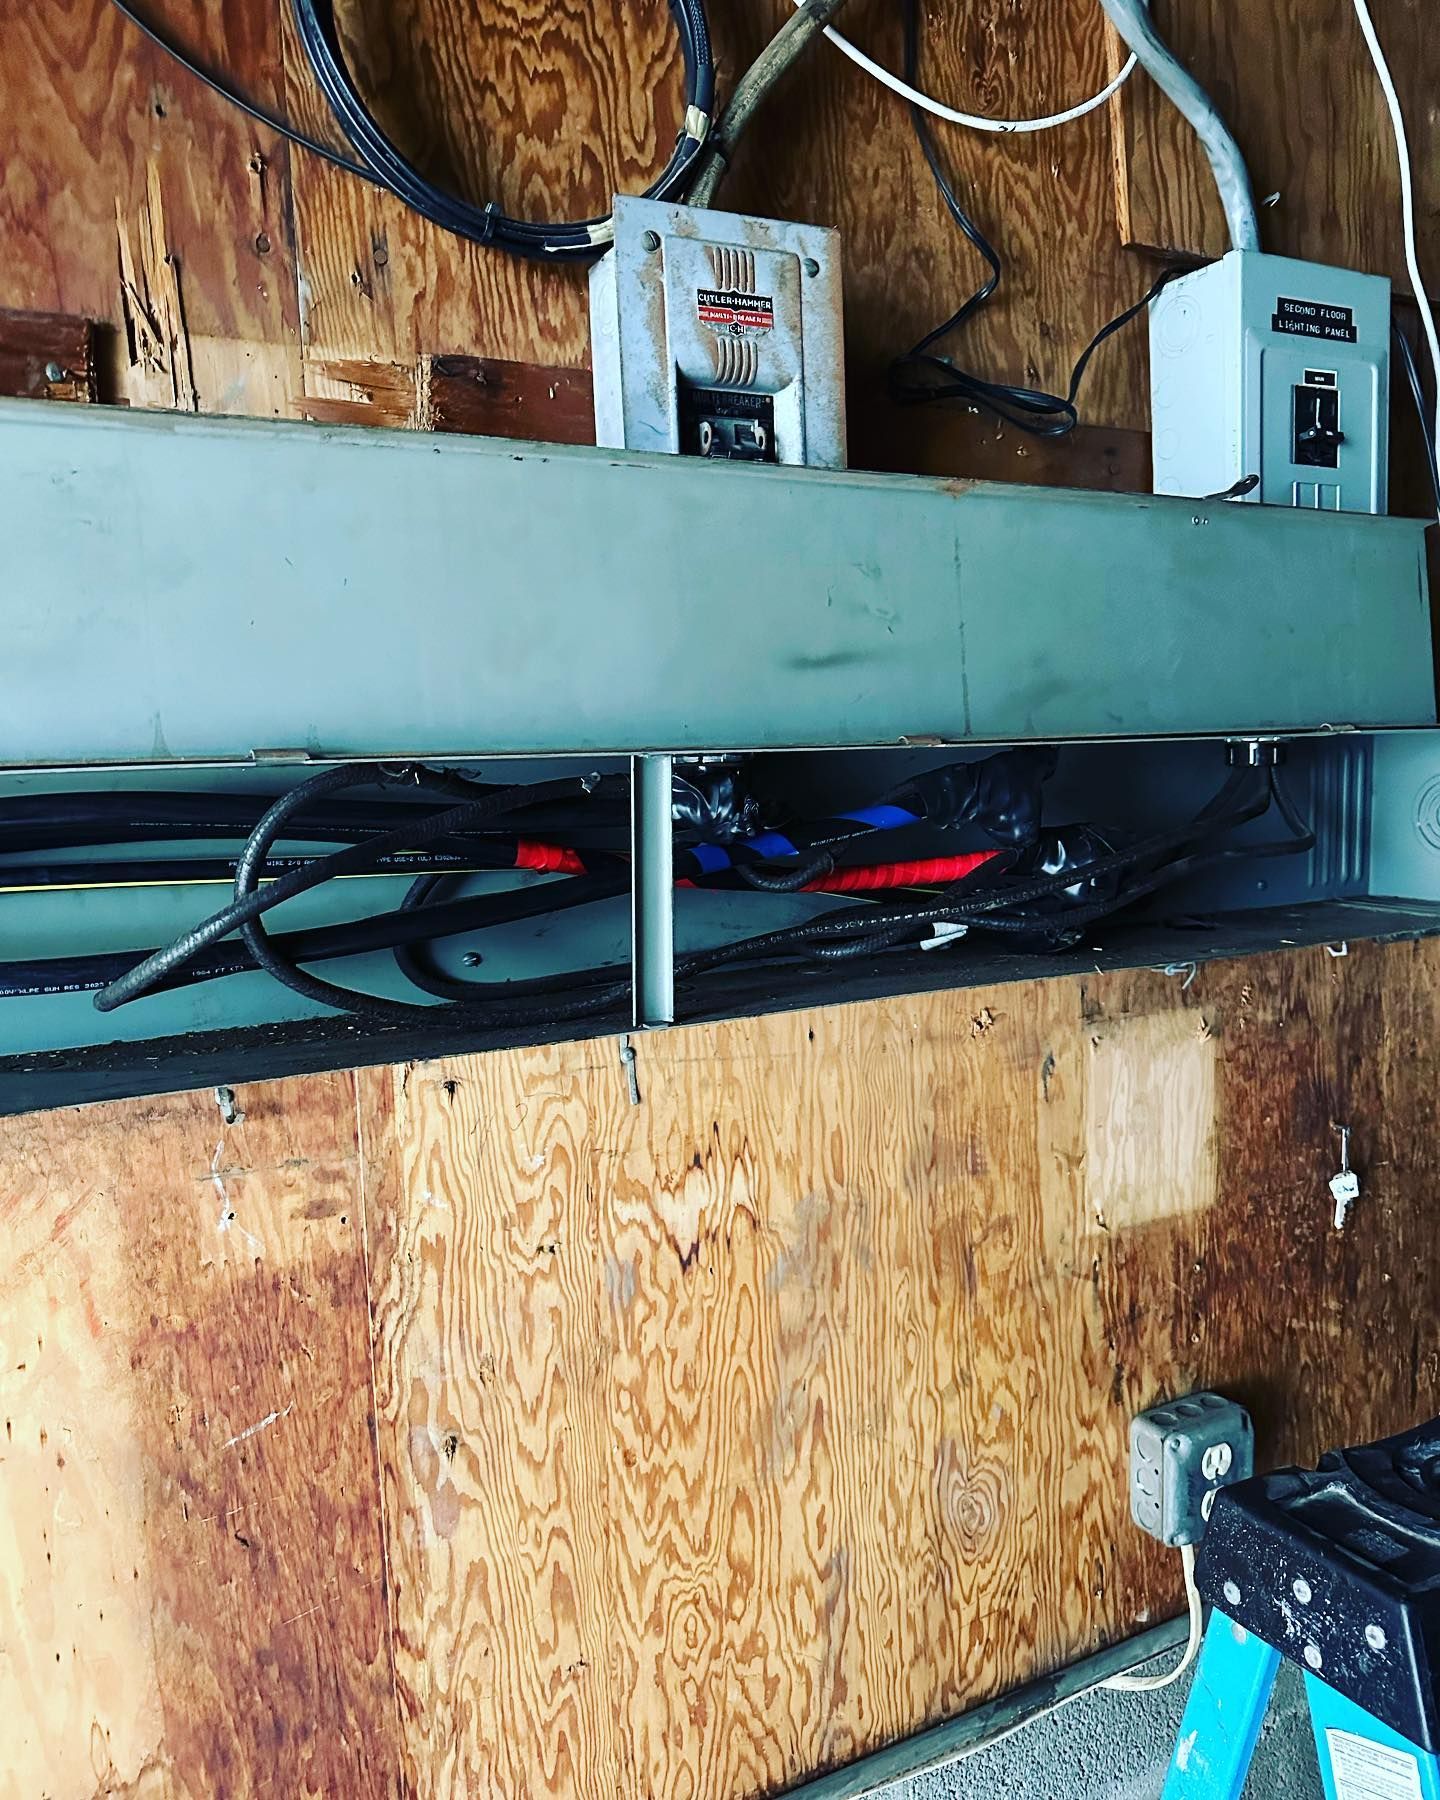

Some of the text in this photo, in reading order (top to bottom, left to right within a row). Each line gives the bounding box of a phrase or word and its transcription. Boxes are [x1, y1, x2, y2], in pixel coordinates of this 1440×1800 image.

[1284, 303, 1346, 321] SECOND FLOOR
[1278, 319, 1350, 338] LIGHTING PANEL
